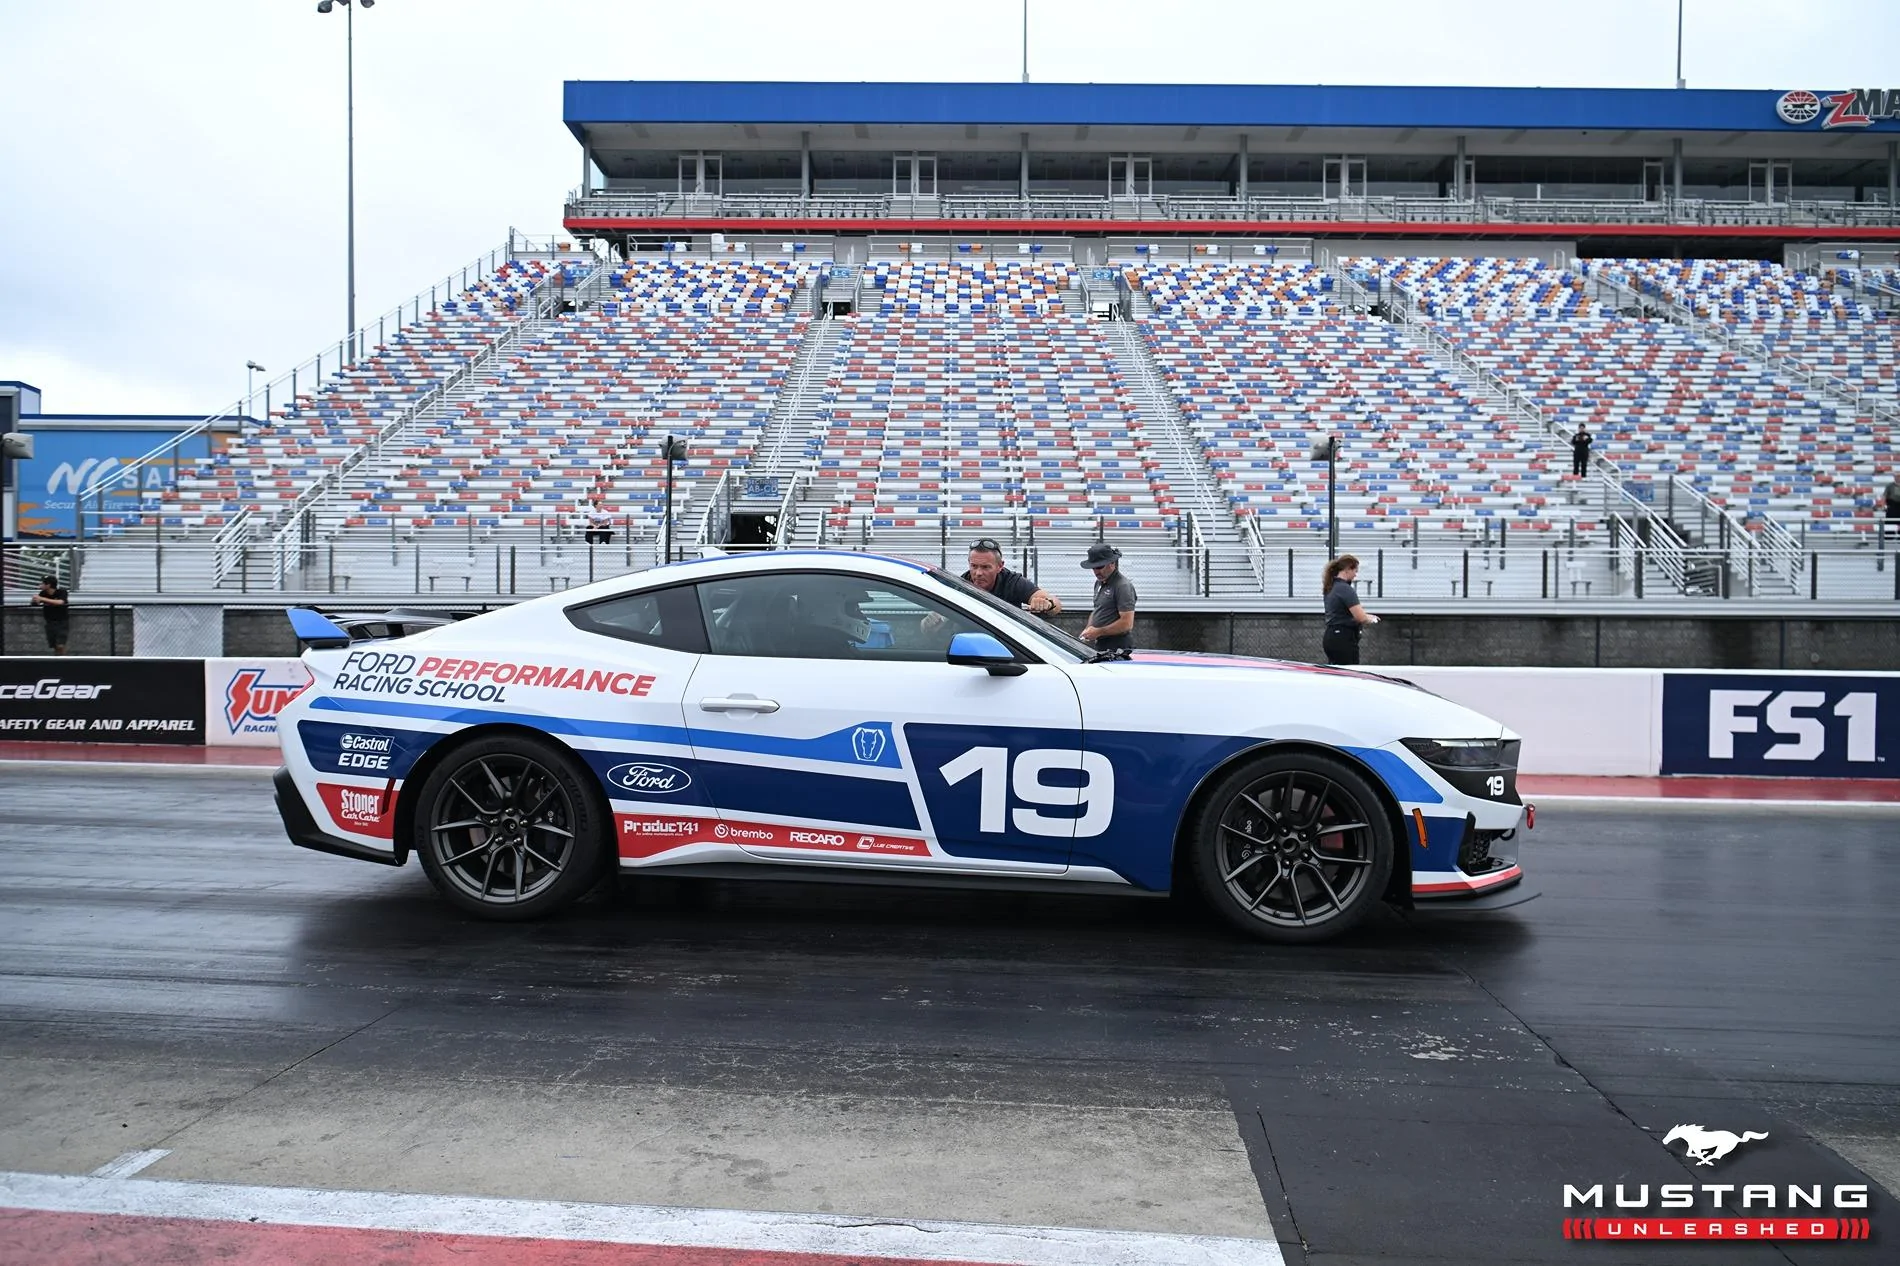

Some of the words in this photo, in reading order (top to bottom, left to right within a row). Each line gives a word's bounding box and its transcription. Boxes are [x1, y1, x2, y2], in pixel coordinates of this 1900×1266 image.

[342, 651, 416, 675] FORD
[416, 656, 656, 697] PERFORMANCE
[333, 673, 413, 695] RACING
[414, 679, 506, 703] SCHOOL
[45, 719, 87, 730] GEAR
[89, 719, 124, 730] AND
[126, 719, 196, 731] APPAREL
[1708, 689, 1877, 762] FS1
[353, 736, 390, 751] Castrol
[338, 752, 391, 770] EDGE
[623, 766, 676, 789] Ford
[1486, 776, 1505, 796] 19
[341, 789, 380, 815] Stoner
[939, 746, 1114, 838] 19
[341, 809, 359, 820] Car
[359, 811, 380, 823] Care
[730, 828, 774, 840] brembo
[789, 832, 844, 846] RECARO
